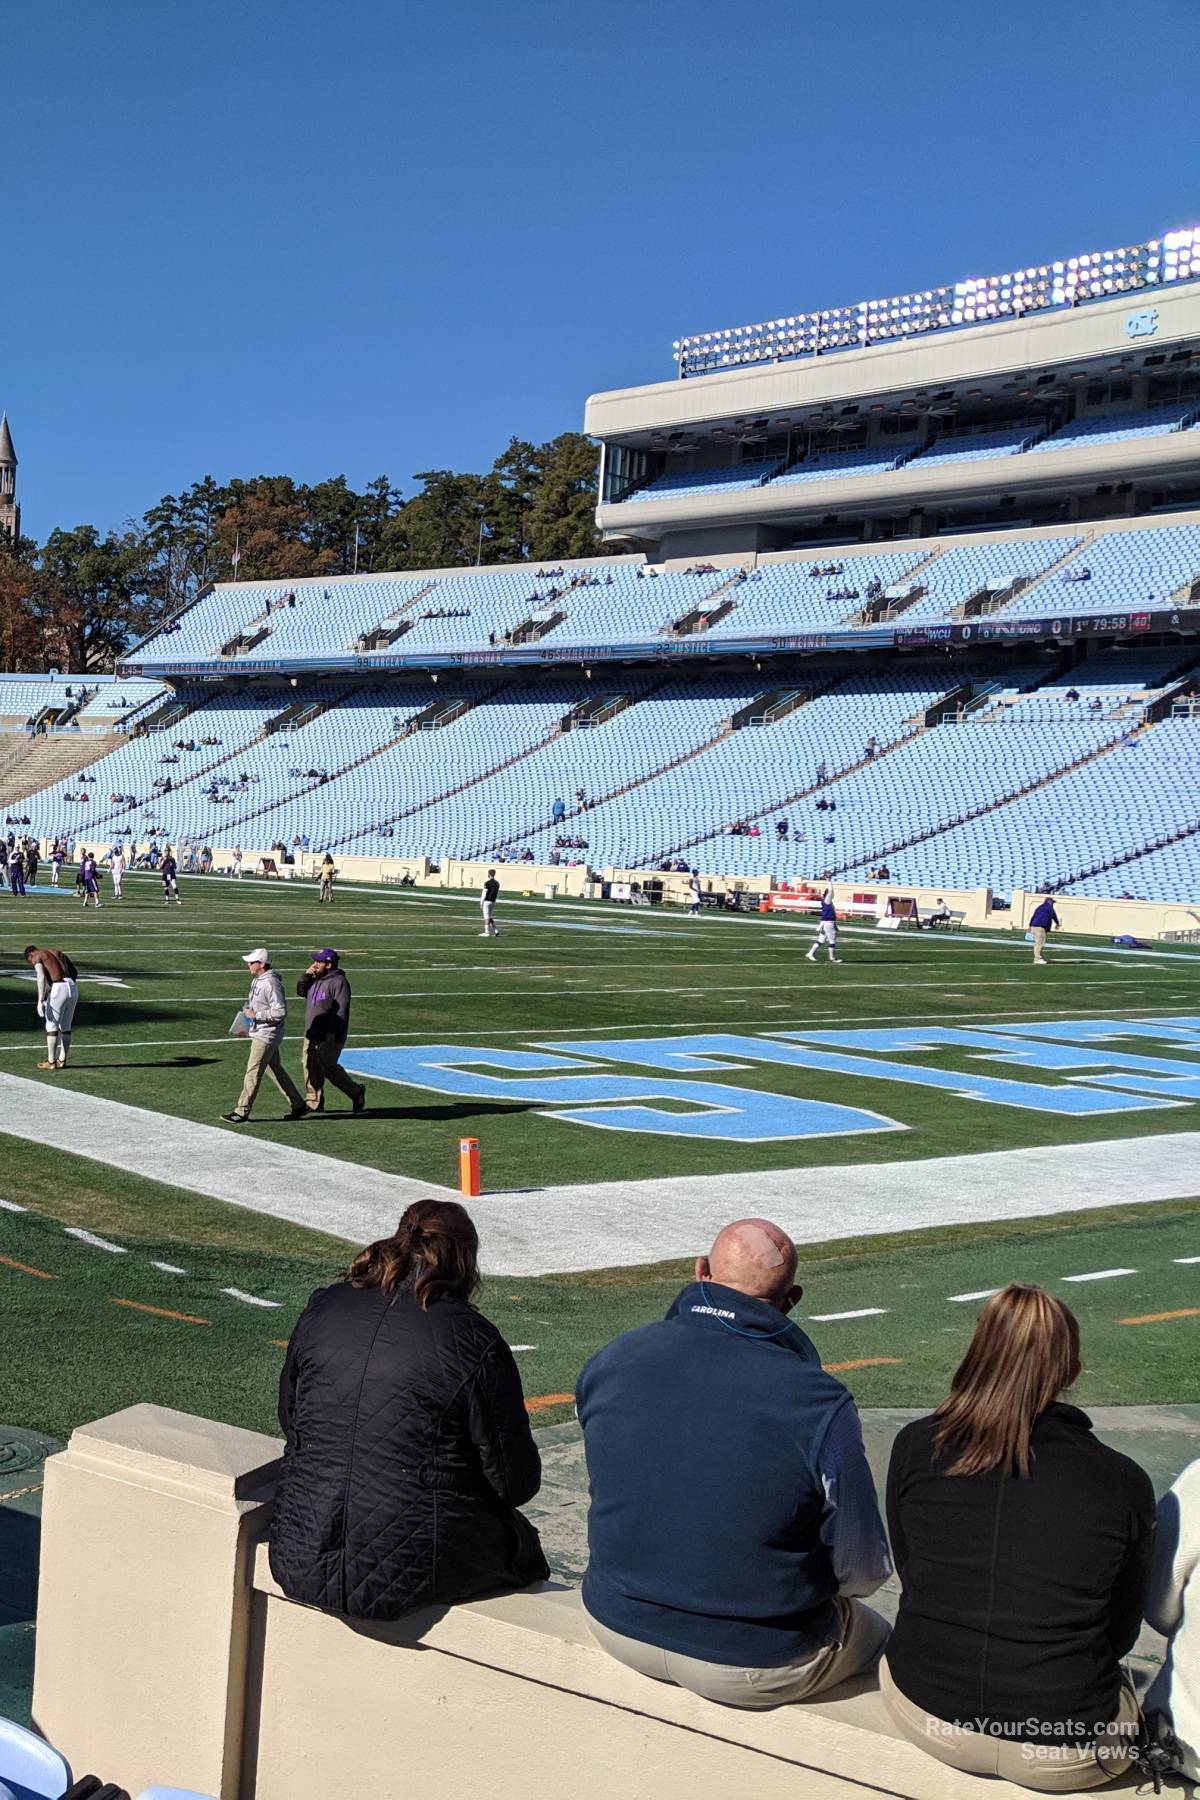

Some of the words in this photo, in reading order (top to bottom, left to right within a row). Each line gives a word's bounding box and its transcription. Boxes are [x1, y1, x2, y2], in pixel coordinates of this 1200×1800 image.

[1051, 620, 1061, 634] 0
[1093, 616, 1127, 630] 79:58
[930, 628, 951, 639] WCU
[962, 626, 970, 639] 0
[165, 663, 201, 673] WELCOME
[245, 660, 281, 672] STADIUM
[357, 657, 368, 667] 99
[690, 1305, 736, 1320] CAROLINA
